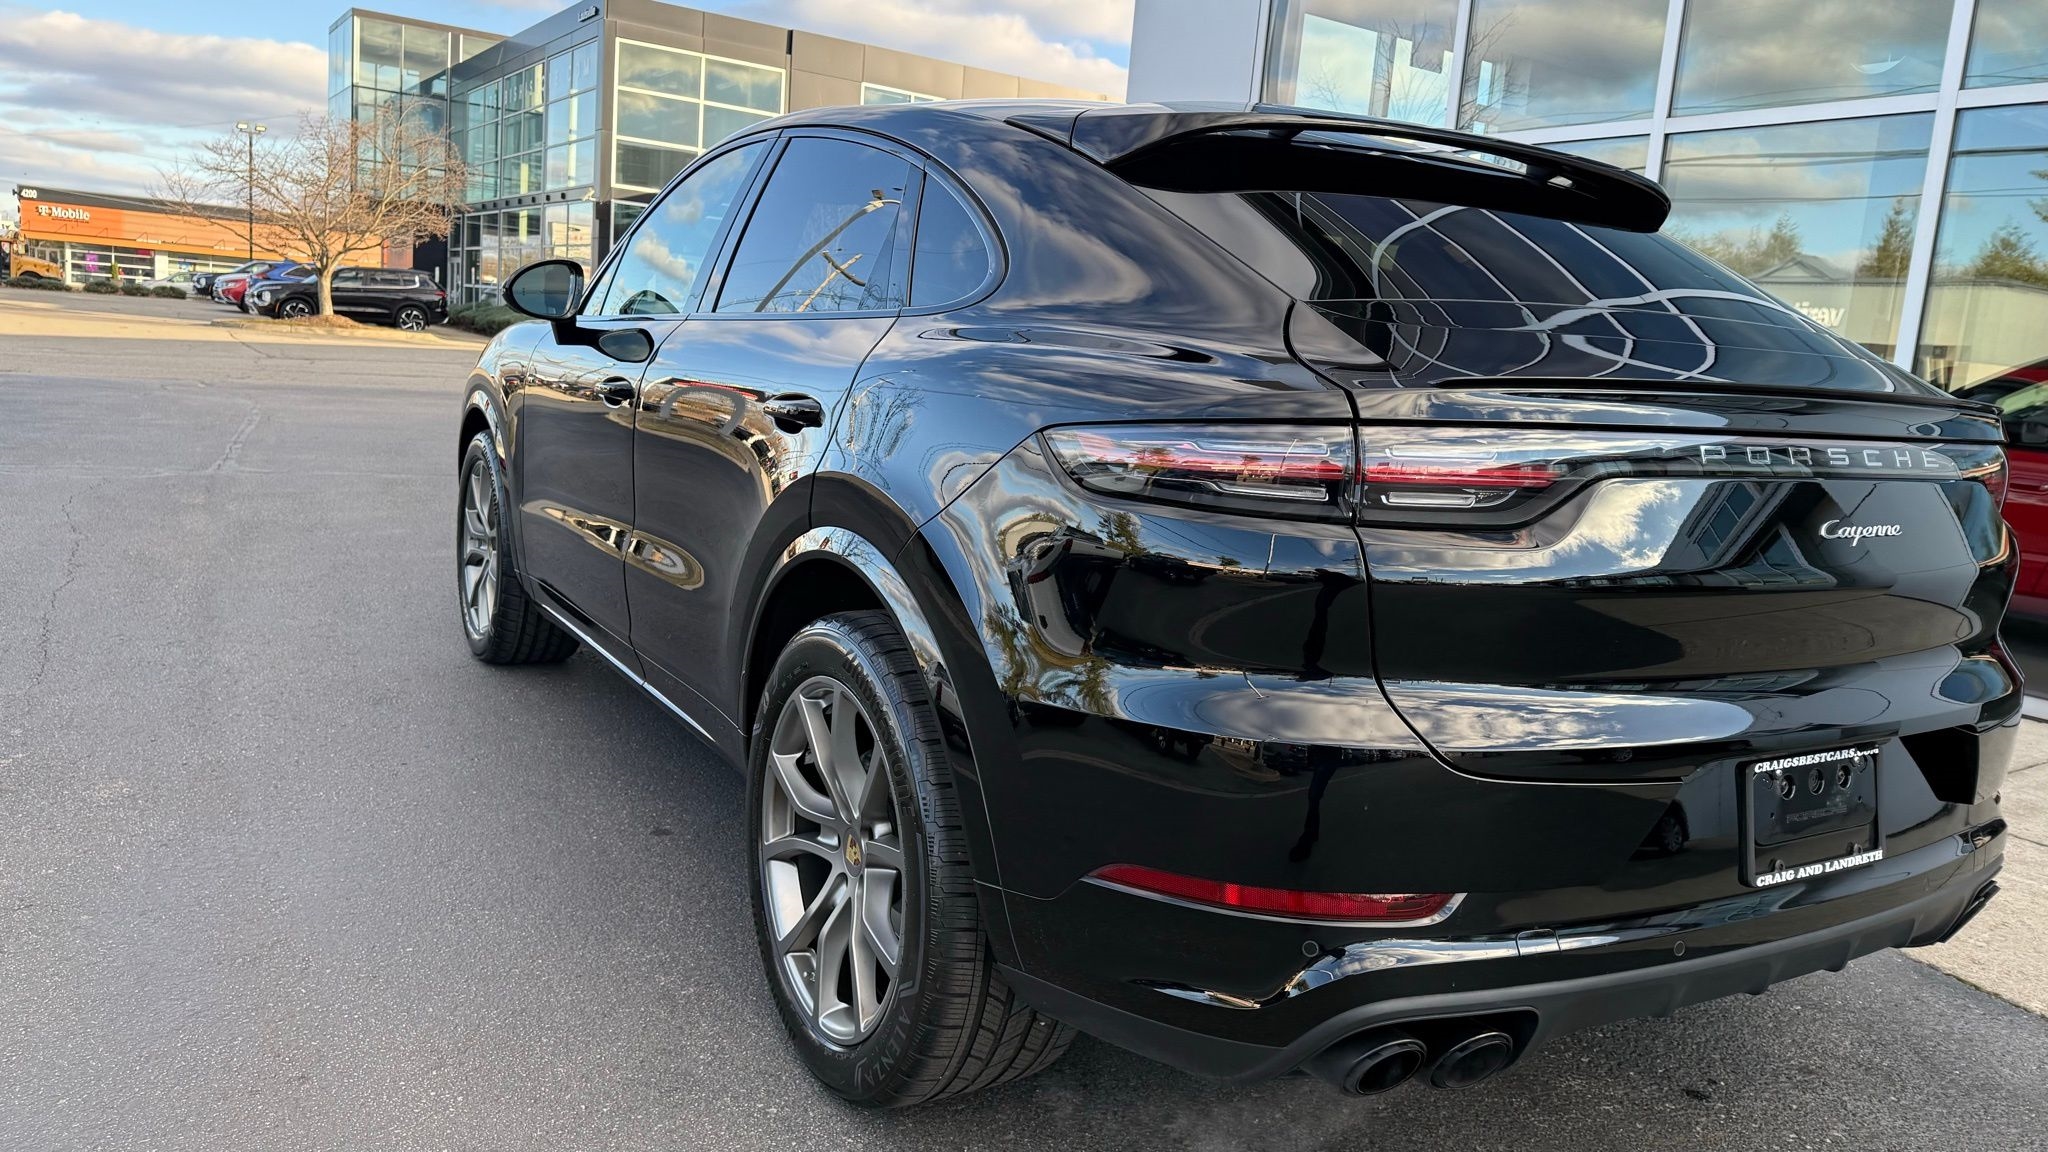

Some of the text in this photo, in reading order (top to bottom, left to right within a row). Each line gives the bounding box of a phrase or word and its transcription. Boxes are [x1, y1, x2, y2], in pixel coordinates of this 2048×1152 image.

[21, 188, 38, 199] 4200
[1700, 445, 1941, 468] PORSCHE
[1819, 519, 1903, 547] Cayenne
[1756, 849, 1884, 887] CRAIG AND LANDRETH
